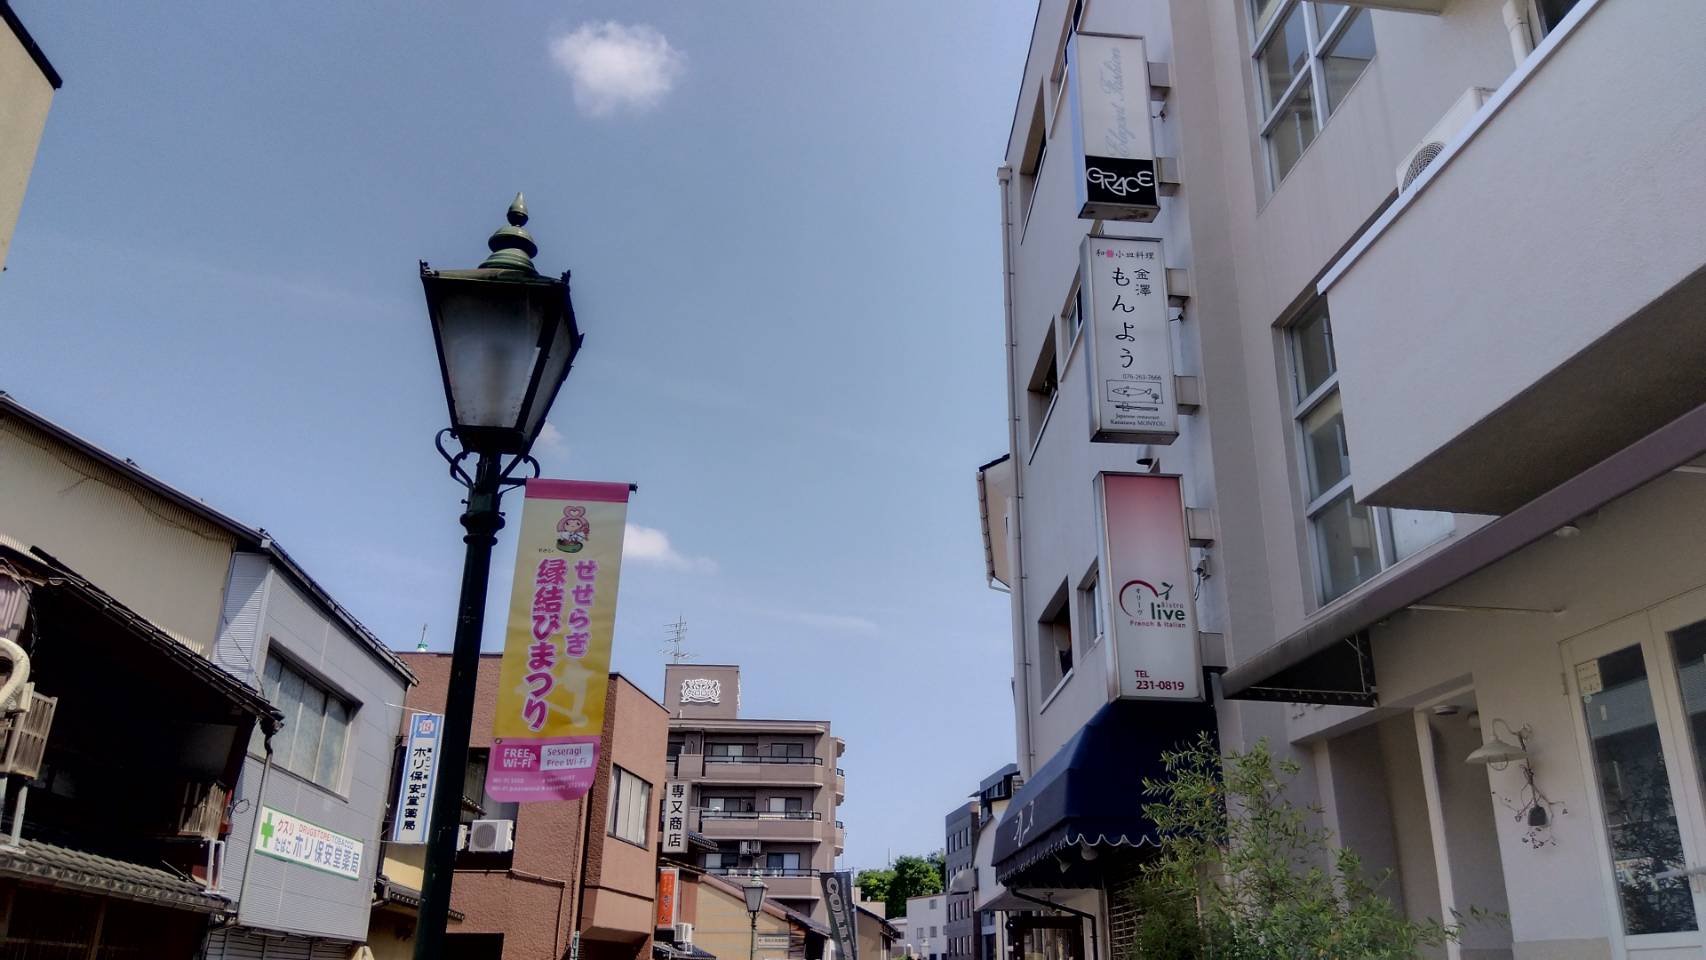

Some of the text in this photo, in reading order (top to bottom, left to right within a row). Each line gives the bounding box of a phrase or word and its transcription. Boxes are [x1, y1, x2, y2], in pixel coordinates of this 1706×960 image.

[1086, 166, 1154, 196] GRACE
[1111, 266, 1136, 368] もんよう
[565, 559, 599, 657] せせらぎ
[1129, 620, 1155, 628] French
[523, 558, 568, 732] 縁結びまつり
[1135, 669, 1150, 679] TEL
[1135, 680, 1185, 691] 231-0819
[503, 748, 530, 758] FREE
[547, 746, 583, 757] Seseragi
[503, 758, 532, 769] Wi-Fi
[546, 757, 587, 767] Free Wi-Fi
[402, 747, 426, 831] ホリ保安堂薬局
[668, 784, 685, 848] 専又商店
[278, 818, 295, 836] クスリ
[274, 837, 292, 854] たばこ
[293, 834, 360, 874] ホリ保安堂薬局
